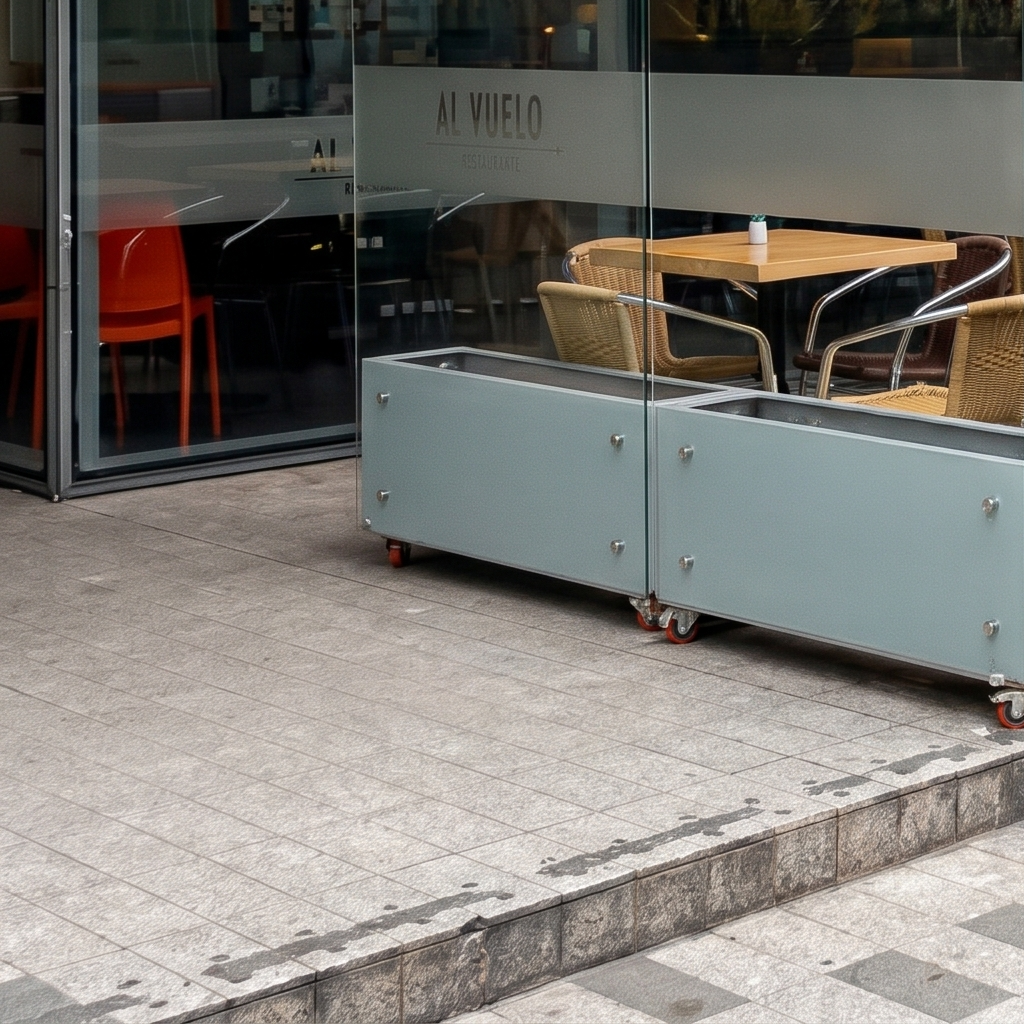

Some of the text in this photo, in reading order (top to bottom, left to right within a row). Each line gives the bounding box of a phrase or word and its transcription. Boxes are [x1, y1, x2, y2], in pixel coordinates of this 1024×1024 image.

[435, 90, 543, 141] AL VUELO
[310, 138, 341, 173] AL
